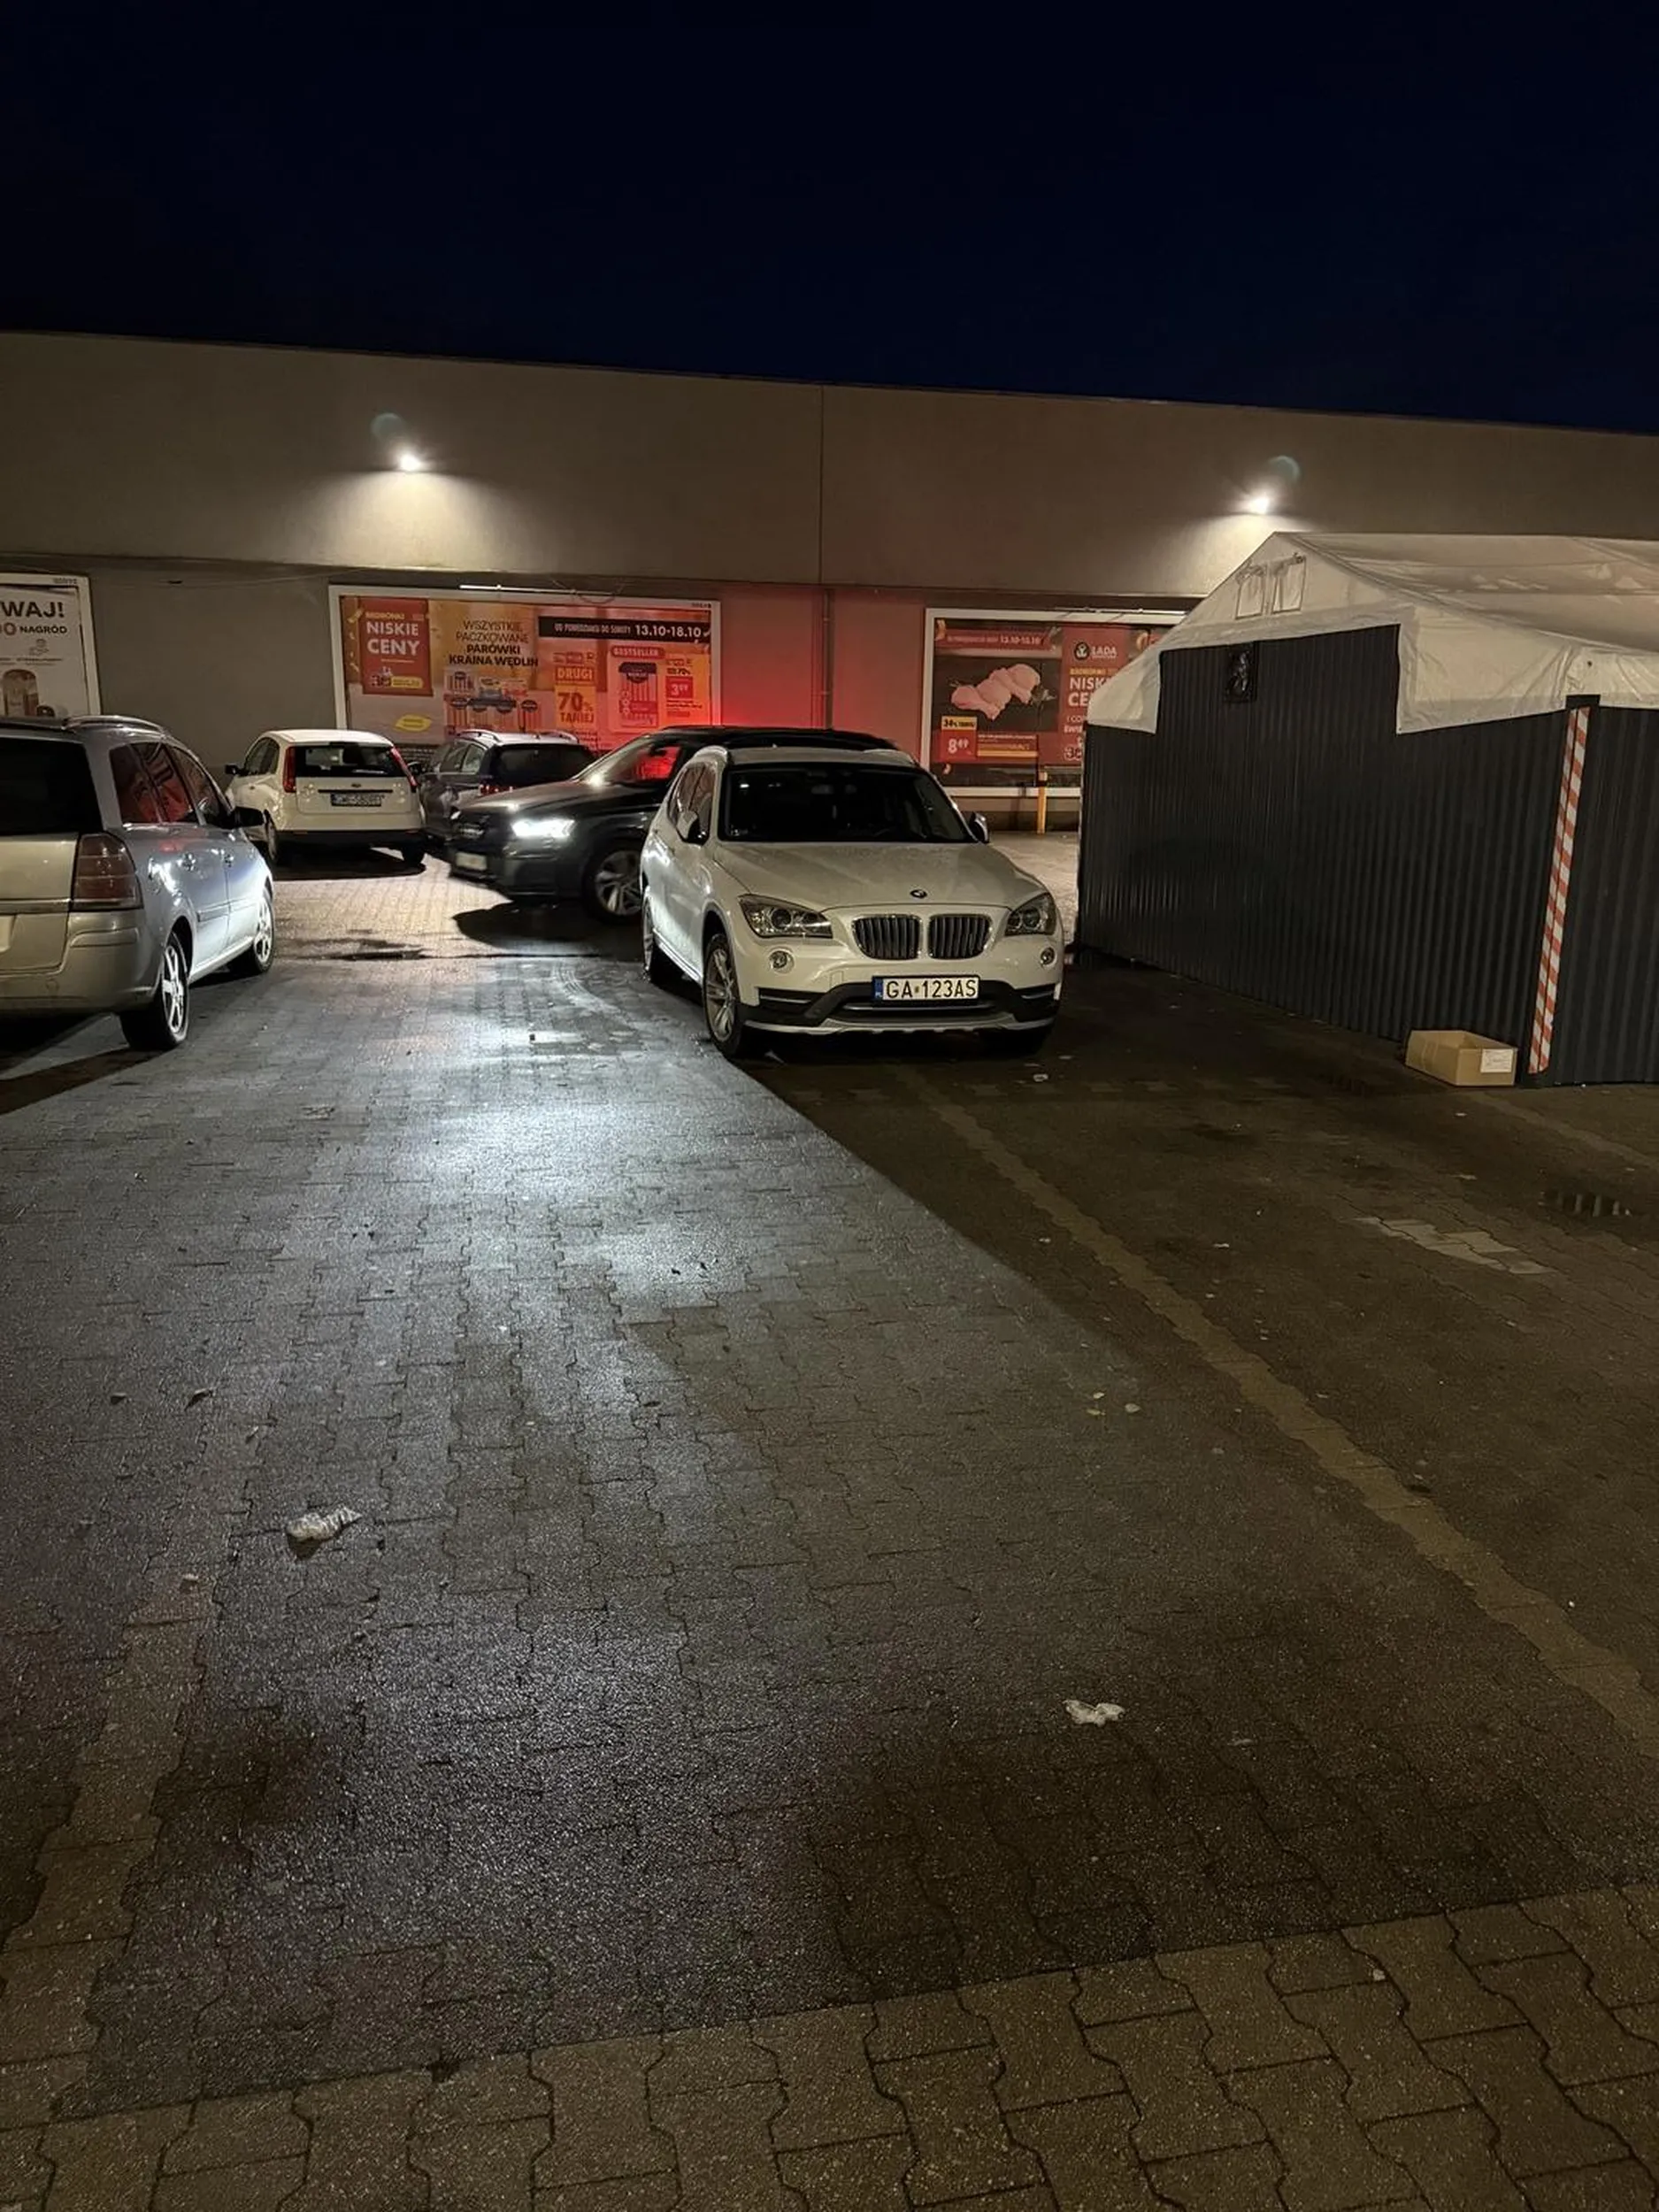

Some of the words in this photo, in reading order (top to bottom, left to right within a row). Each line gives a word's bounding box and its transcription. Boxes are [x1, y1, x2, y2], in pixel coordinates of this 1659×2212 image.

[0, 622, 17, 636] 0
[19, 624, 67, 634] NAGRÓD
[366, 621, 419, 636] NISKIE
[634, 625, 702, 637] 13.10-18.10
[456, 631, 529, 644] PACZKOWANE
[367, 638, 419, 656] CENY
[466, 643, 520, 656] PARÓWKI
[449, 654, 493, 665] KRAINA
[495, 656, 538, 668] WĘDLIN
[557, 666, 593, 680] DRUGI
[1070, 677, 1106, 690] NISK
[1068, 692, 1088, 707] CE
[560, 711, 595, 724] TANIEJ
[887, 980, 913, 999] GA
[921, 979, 977, 998] 123AS
